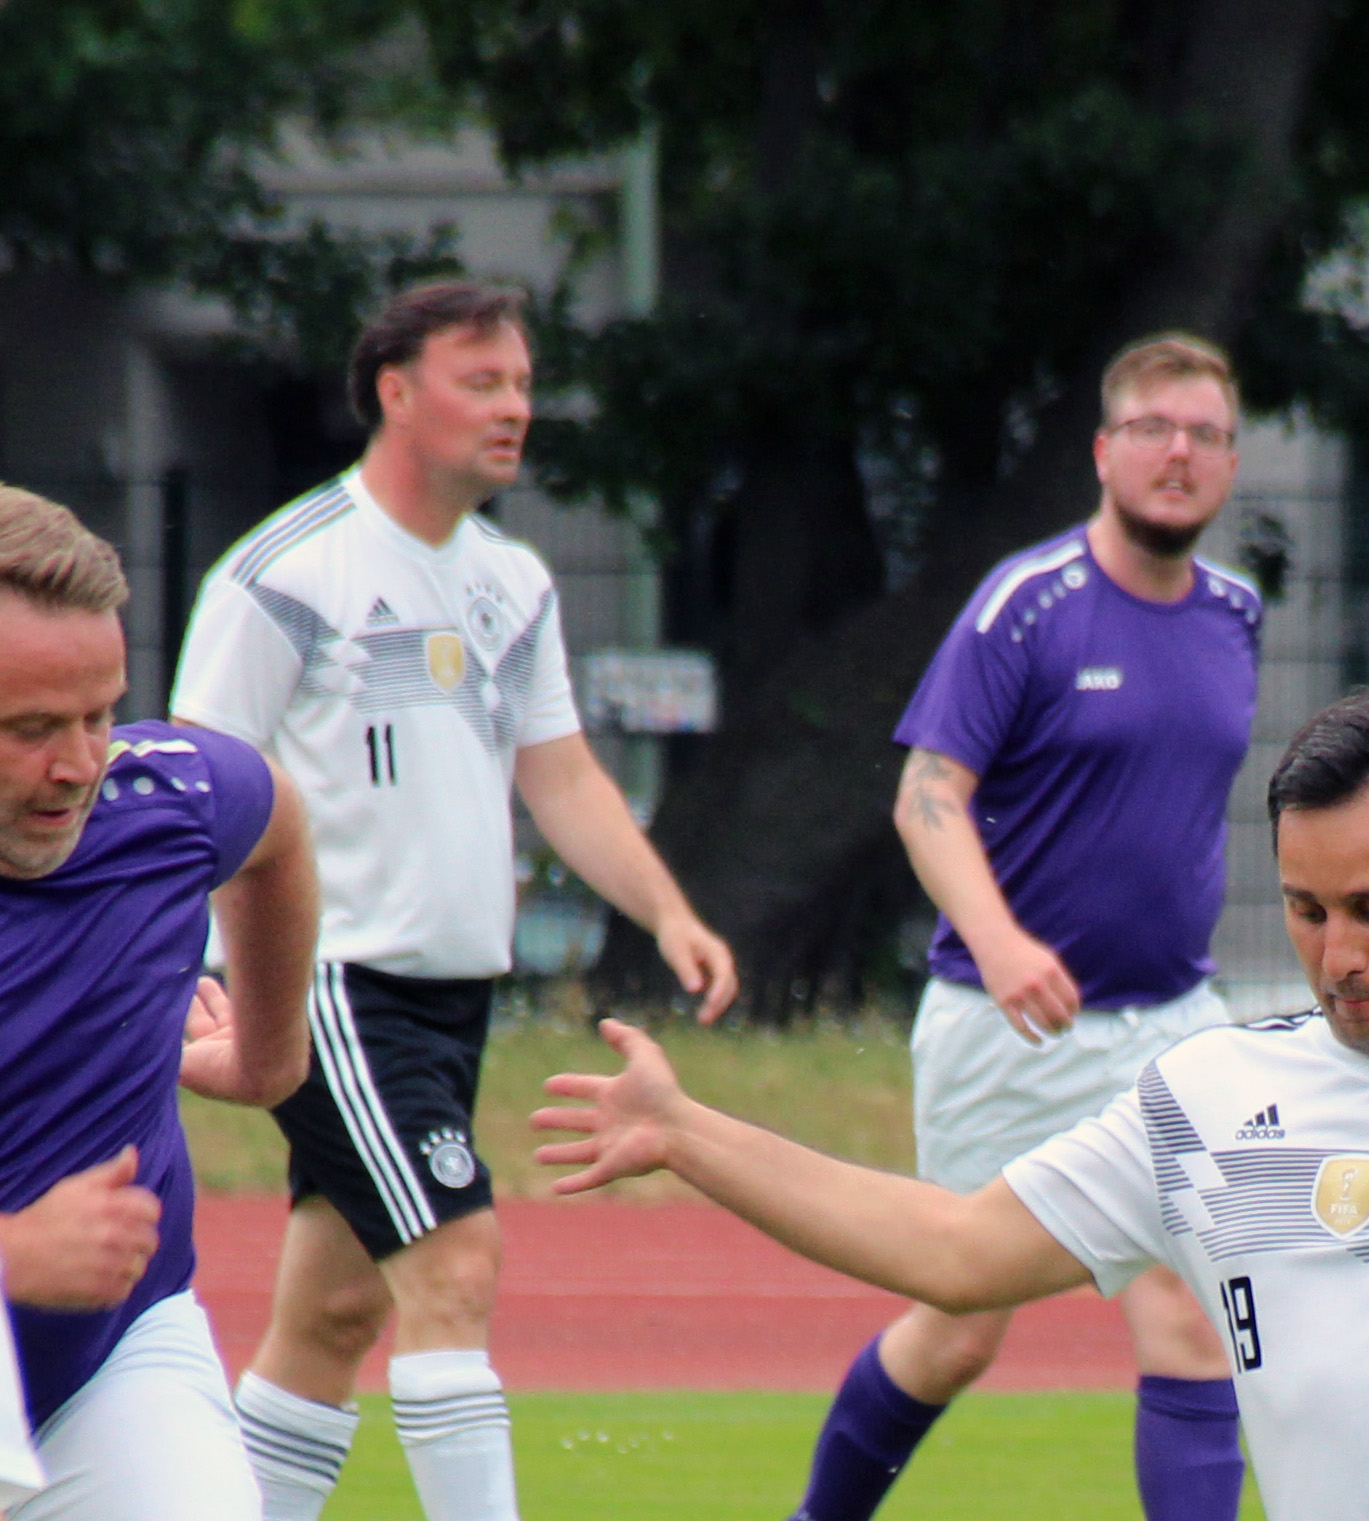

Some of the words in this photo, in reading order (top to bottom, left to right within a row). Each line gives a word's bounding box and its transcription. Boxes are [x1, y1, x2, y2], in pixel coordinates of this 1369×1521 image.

[366, 724, 398, 786] 11
[1236, 1122, 1286, 1140] adidas
[1330, 1204, 1358, 1215] FIFA
[1220, 1276, 1263, 1374] 19
